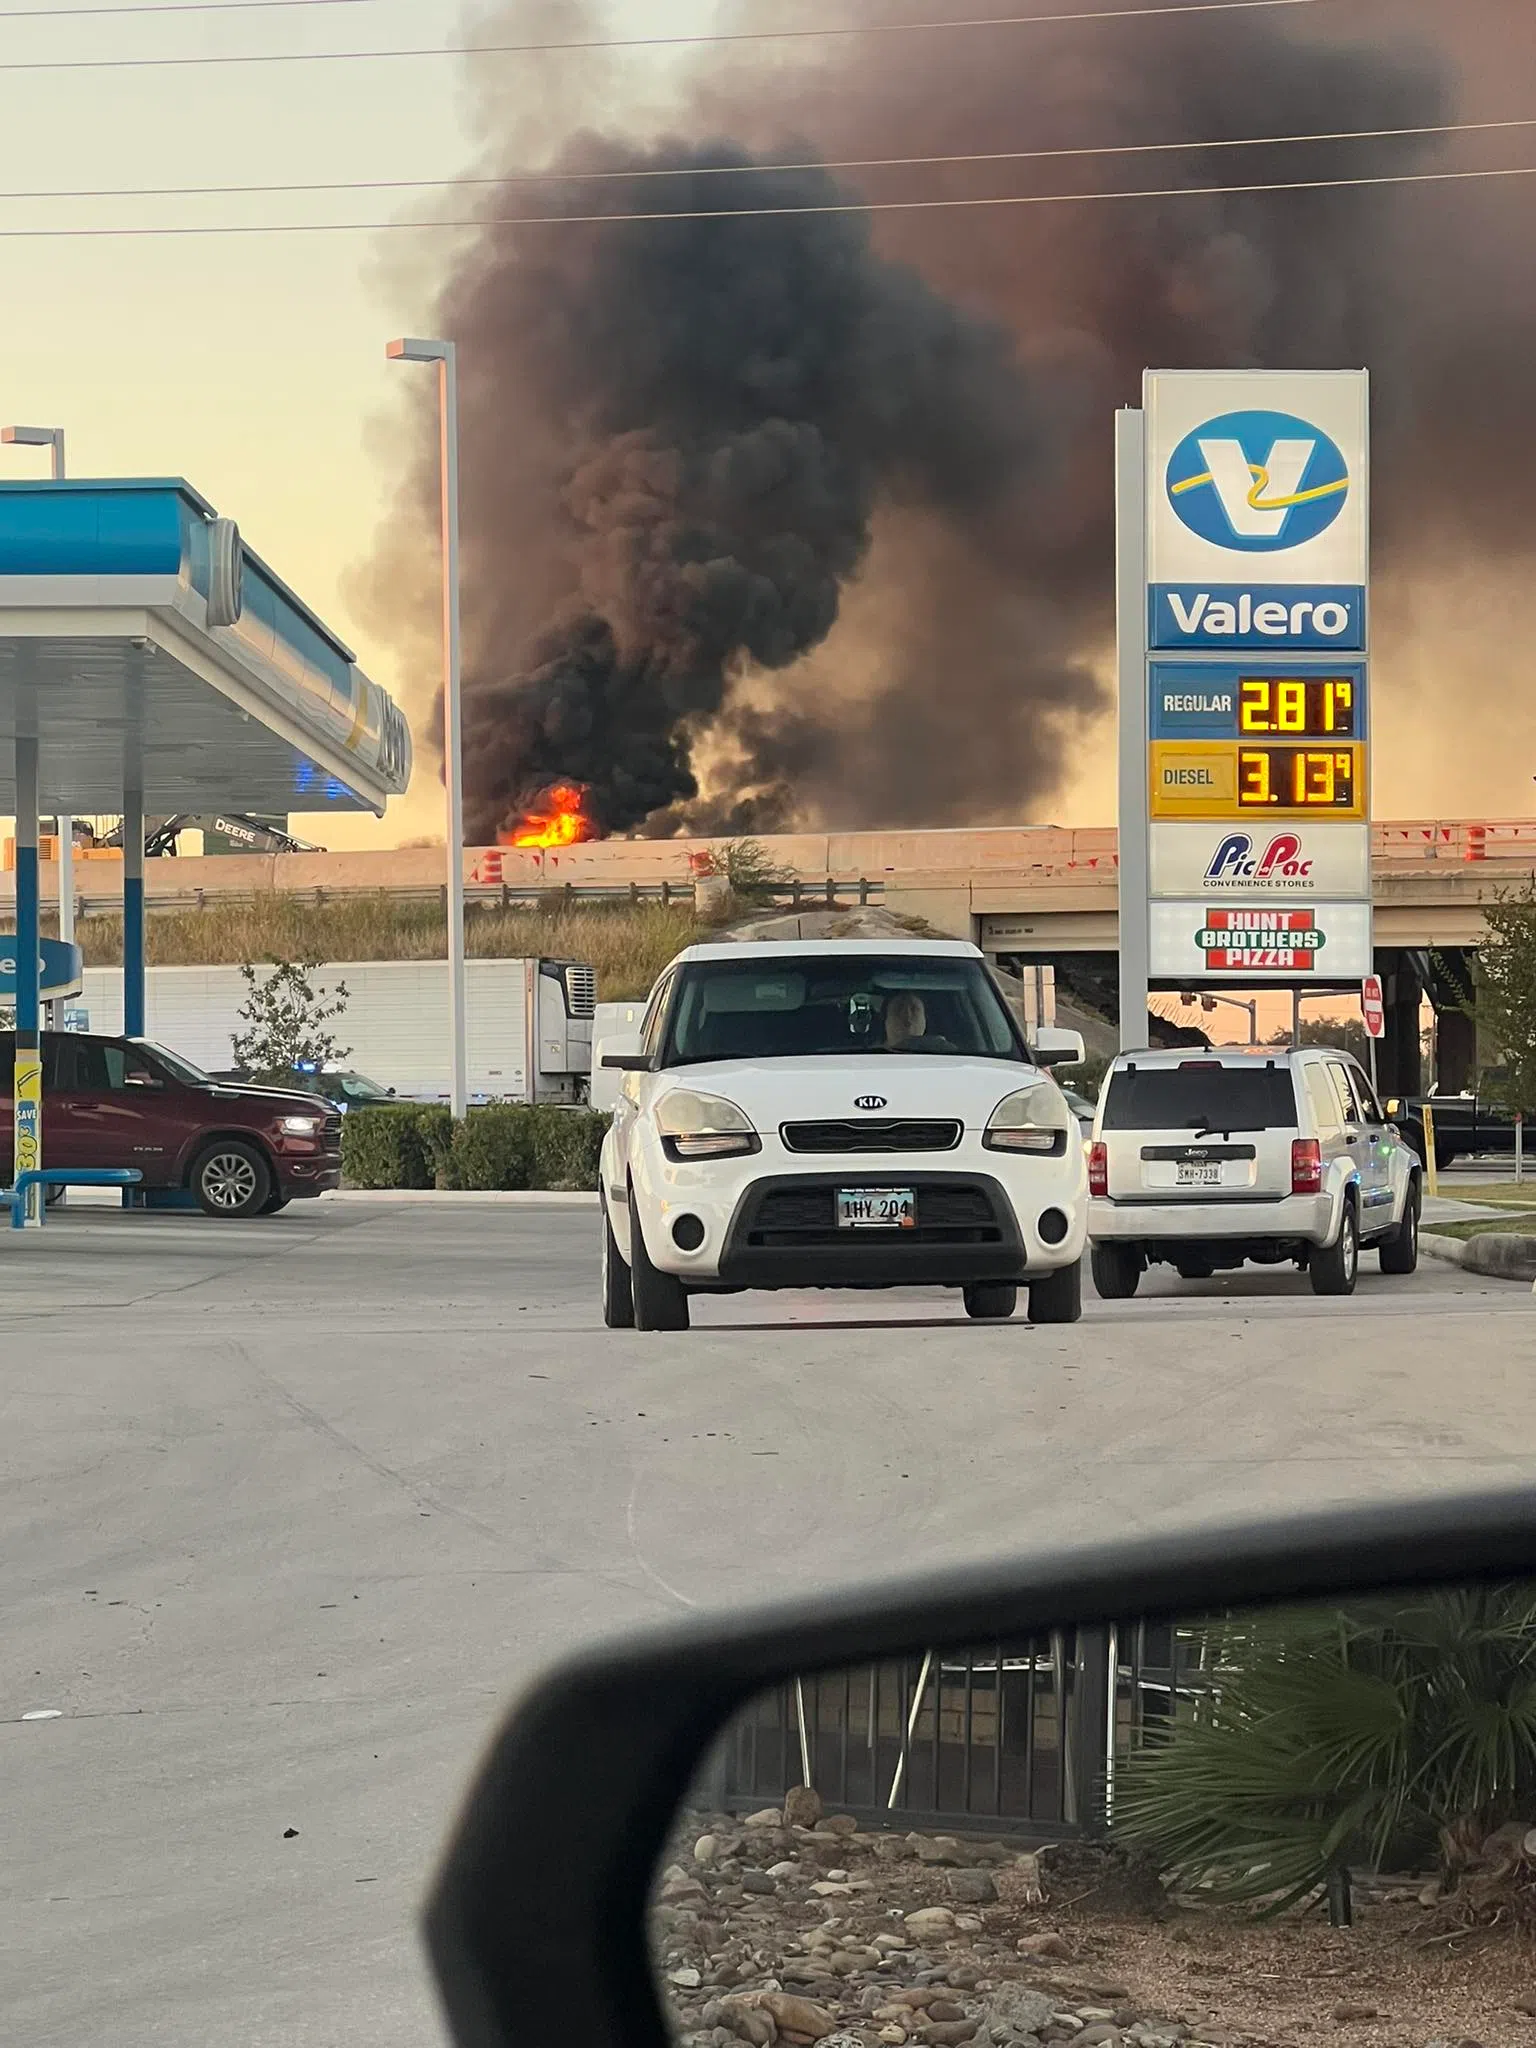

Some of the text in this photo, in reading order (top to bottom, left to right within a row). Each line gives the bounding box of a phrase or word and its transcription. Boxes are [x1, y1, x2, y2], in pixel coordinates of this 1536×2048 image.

[1167, 593, 1348, 636] Valero
[1163, 695, 1232, 712] REGULAR
[1163, 769, 1215, 785] DIESEL
[215, 818, 256, 843] DEERE
[1204, 832, 1257, 878] Pic
[1203, 880, 1315, 888] CONVENIENCE STORES
[1227, 912, 1293, 931] HUNT
[1201, 931, 1319, 948] BROTHERS
[1226, 948, 1295, 966] PIZZA
[859, 1097, 884, 1107] KIA
[16, 1108, 37, 1121] SAVE
[880, 1200, 908, 1218] 204
